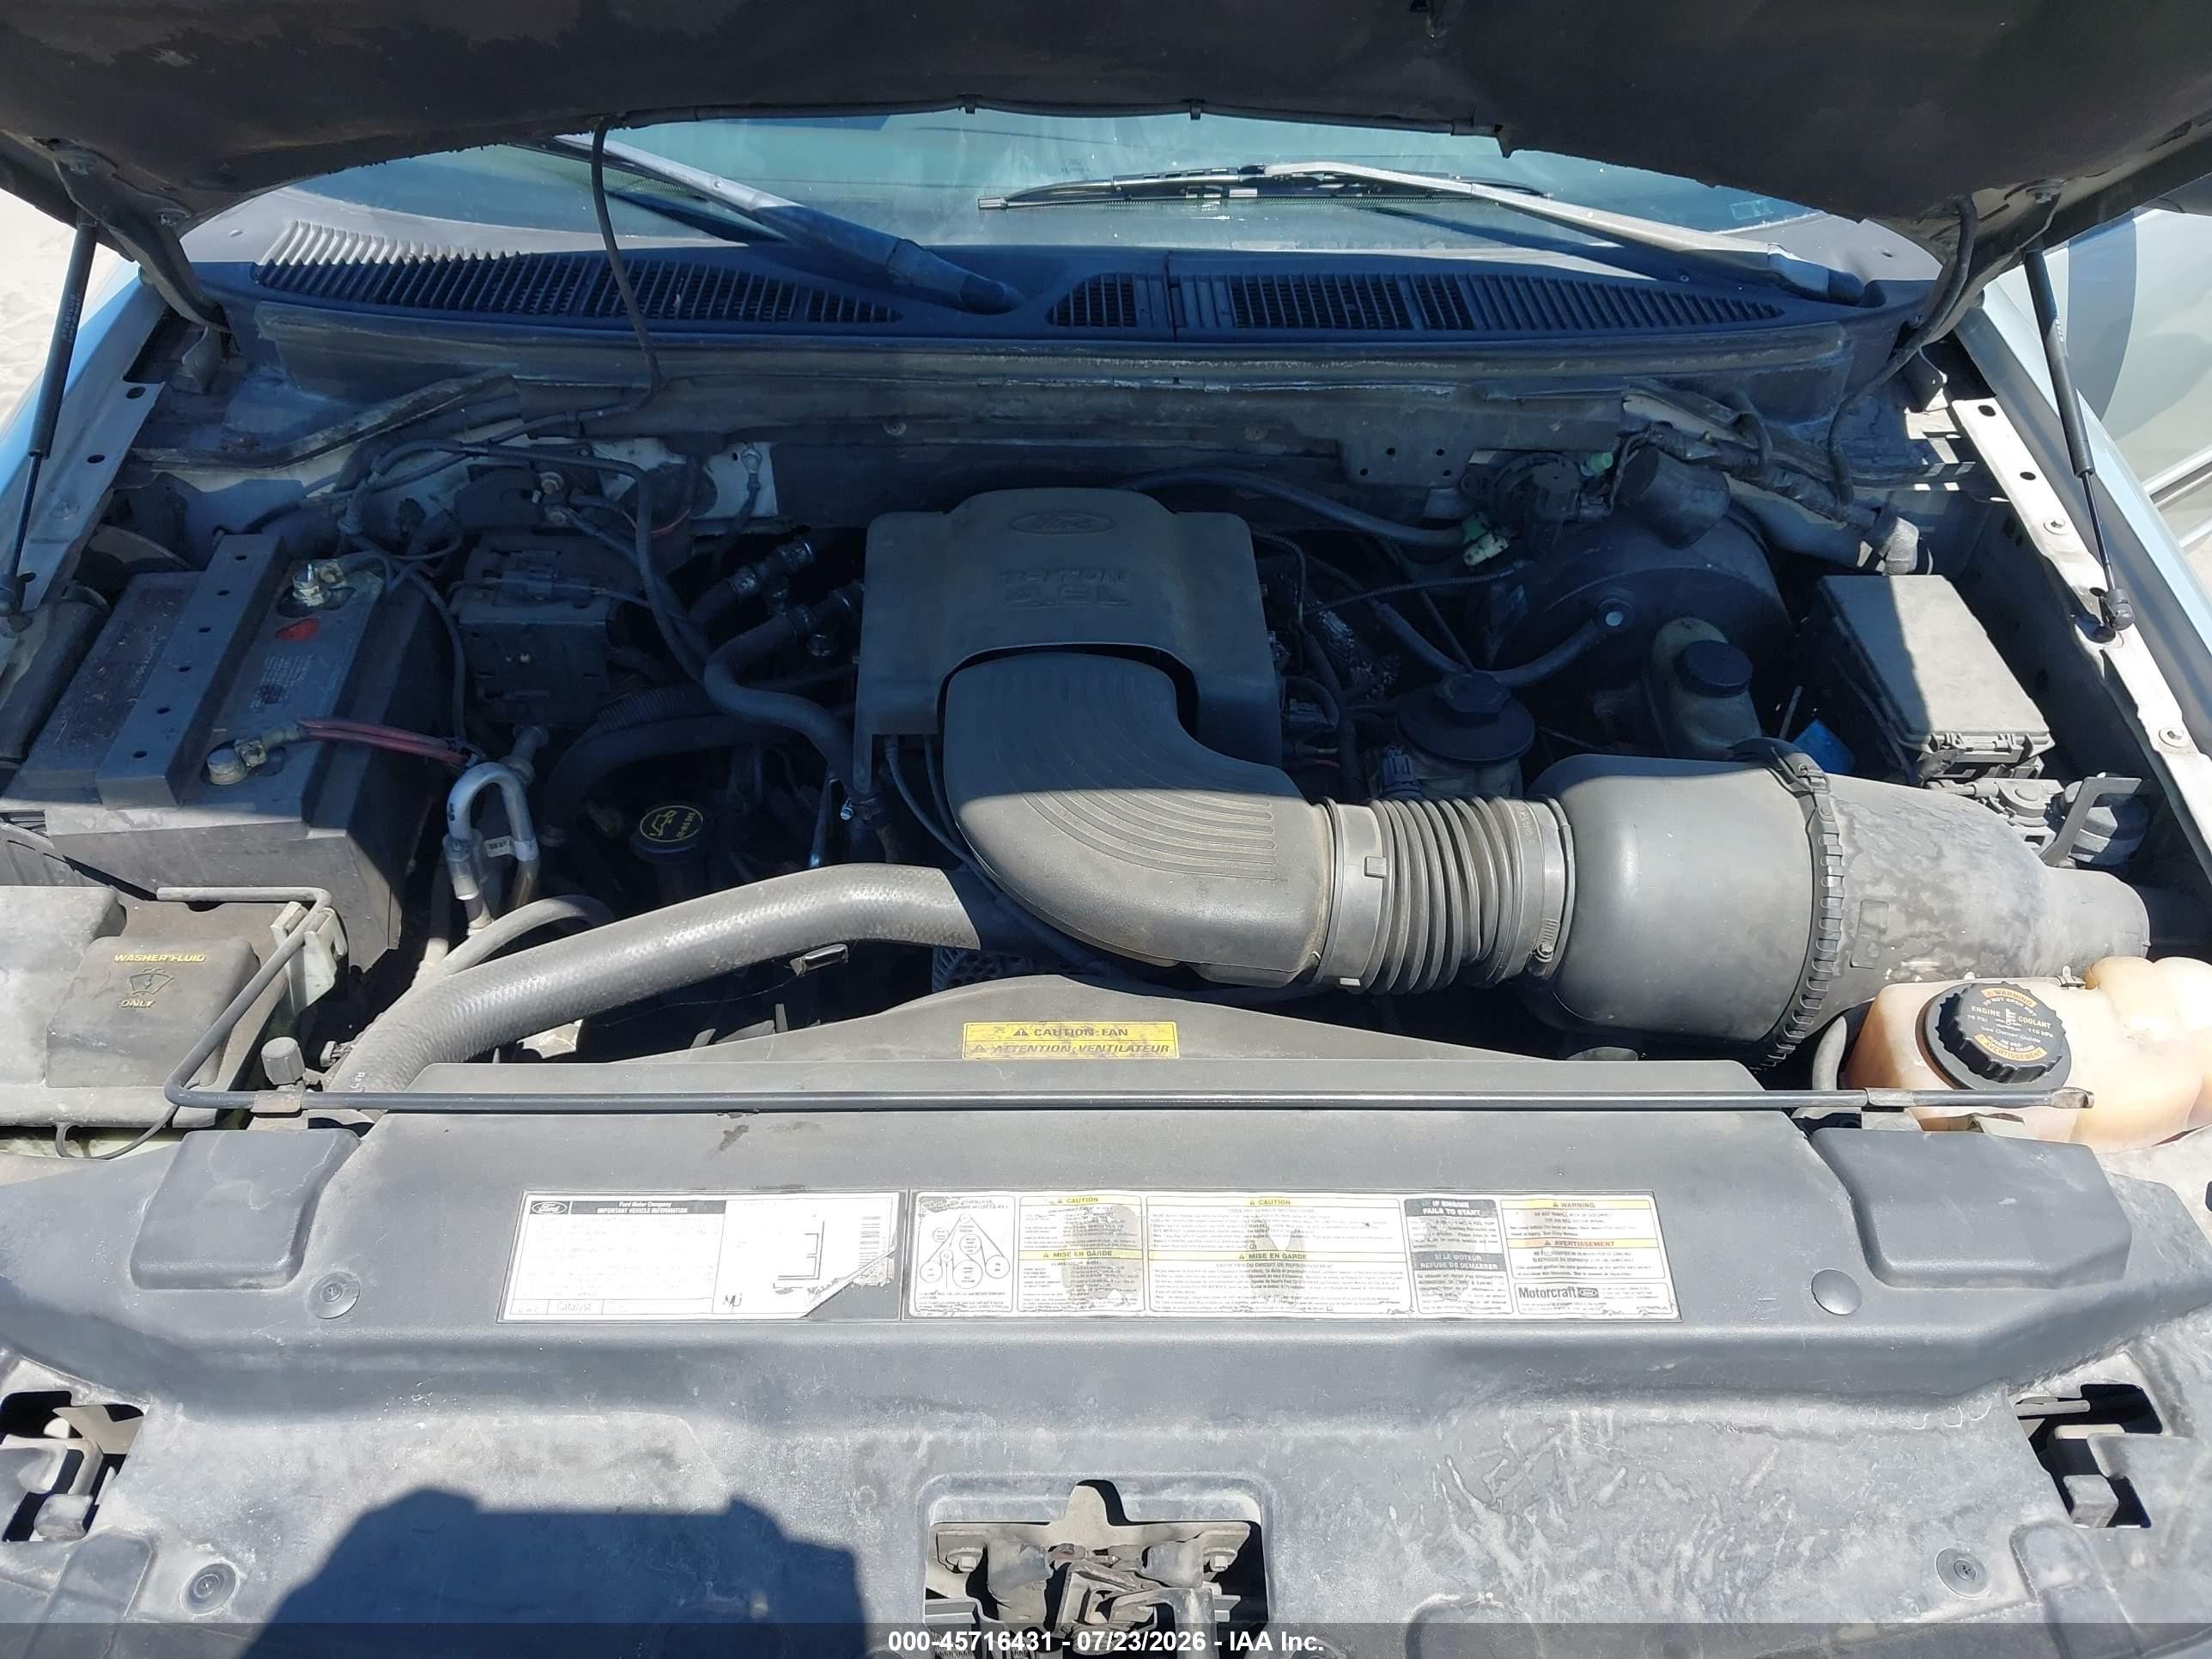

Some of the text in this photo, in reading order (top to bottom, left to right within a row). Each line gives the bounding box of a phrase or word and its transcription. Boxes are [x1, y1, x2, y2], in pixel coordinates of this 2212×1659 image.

[114, 954, 207, 963] WASHER FLUID
[120, 999, 155, 1008] ONLY
[1993, 989, 2034, 1006] WARNING
[1971, 1006, 2052, 1029] ENGINE COOLANT
[1079, 1044, 1170, 1053] VENTILATEUR
[1984, 1042, 2044, 1060] AVERTISSEMENT
[535, 1202, 564, 1213] Ford
[1518, 1286, 1579, 1299] Motorcraft
[556, 1301, 592, 1314] Catalyst
